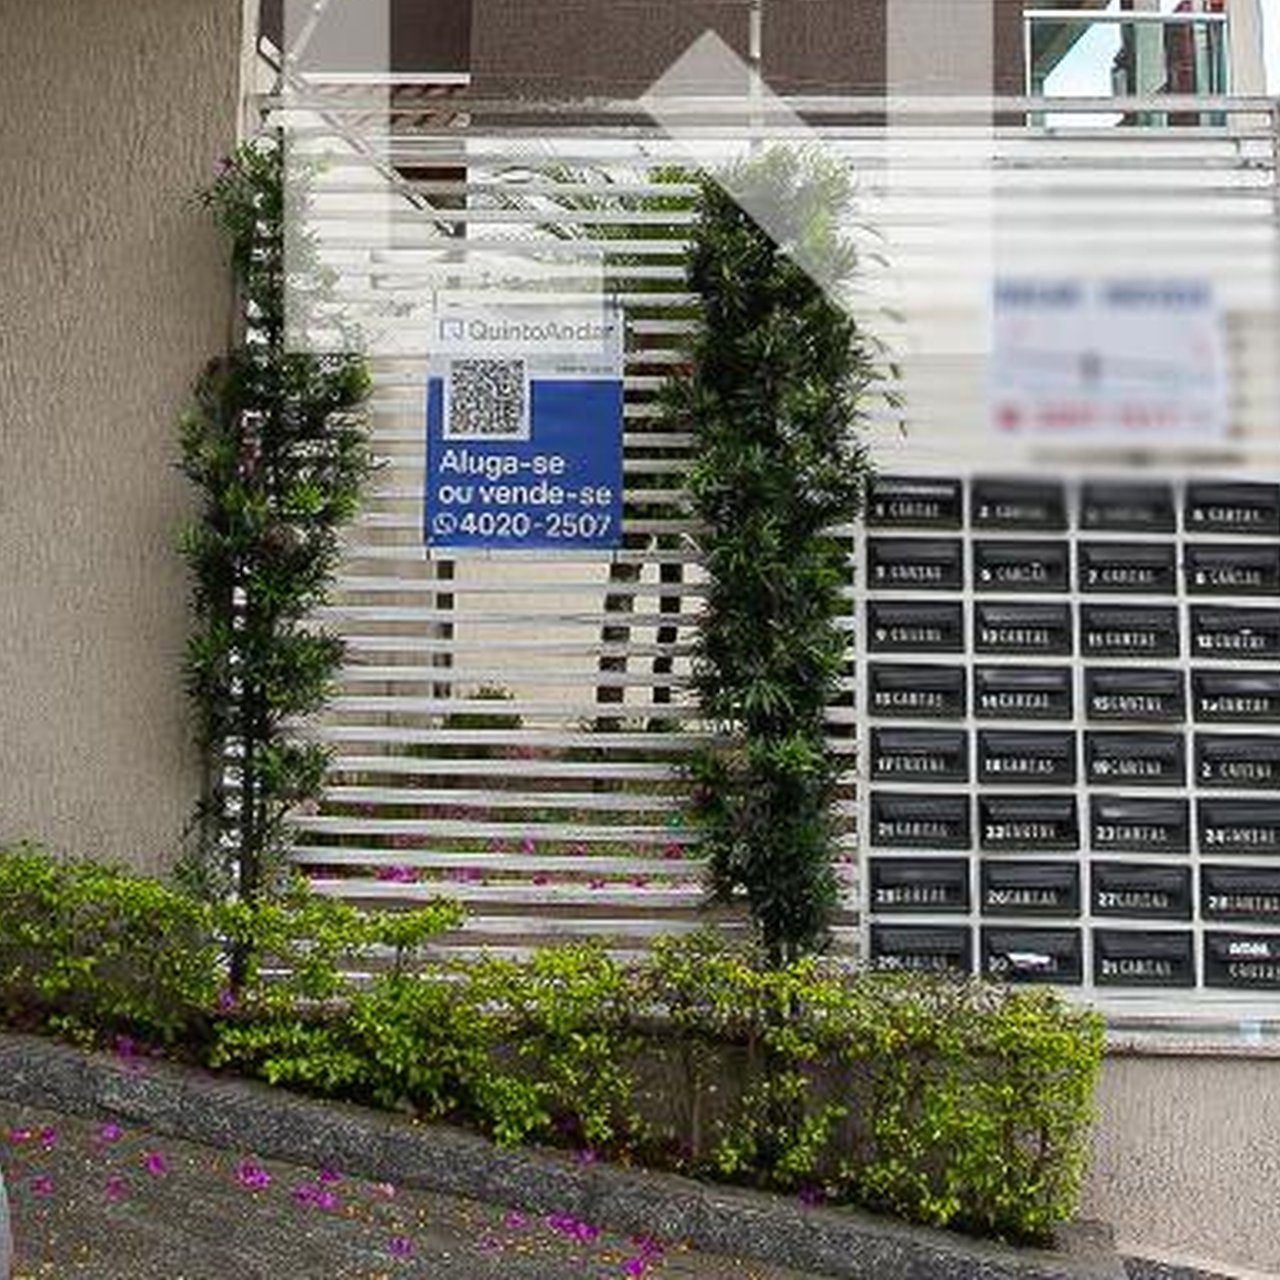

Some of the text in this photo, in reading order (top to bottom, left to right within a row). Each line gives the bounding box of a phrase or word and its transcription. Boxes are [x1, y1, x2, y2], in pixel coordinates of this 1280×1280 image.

[470, 320, 613, 342] QuintoAndar
[439, 449, 566, 481] Aluga-se
[438, 480, 613, 506] ou vende-se
[460, 512, 612, 538] 4020-2507
